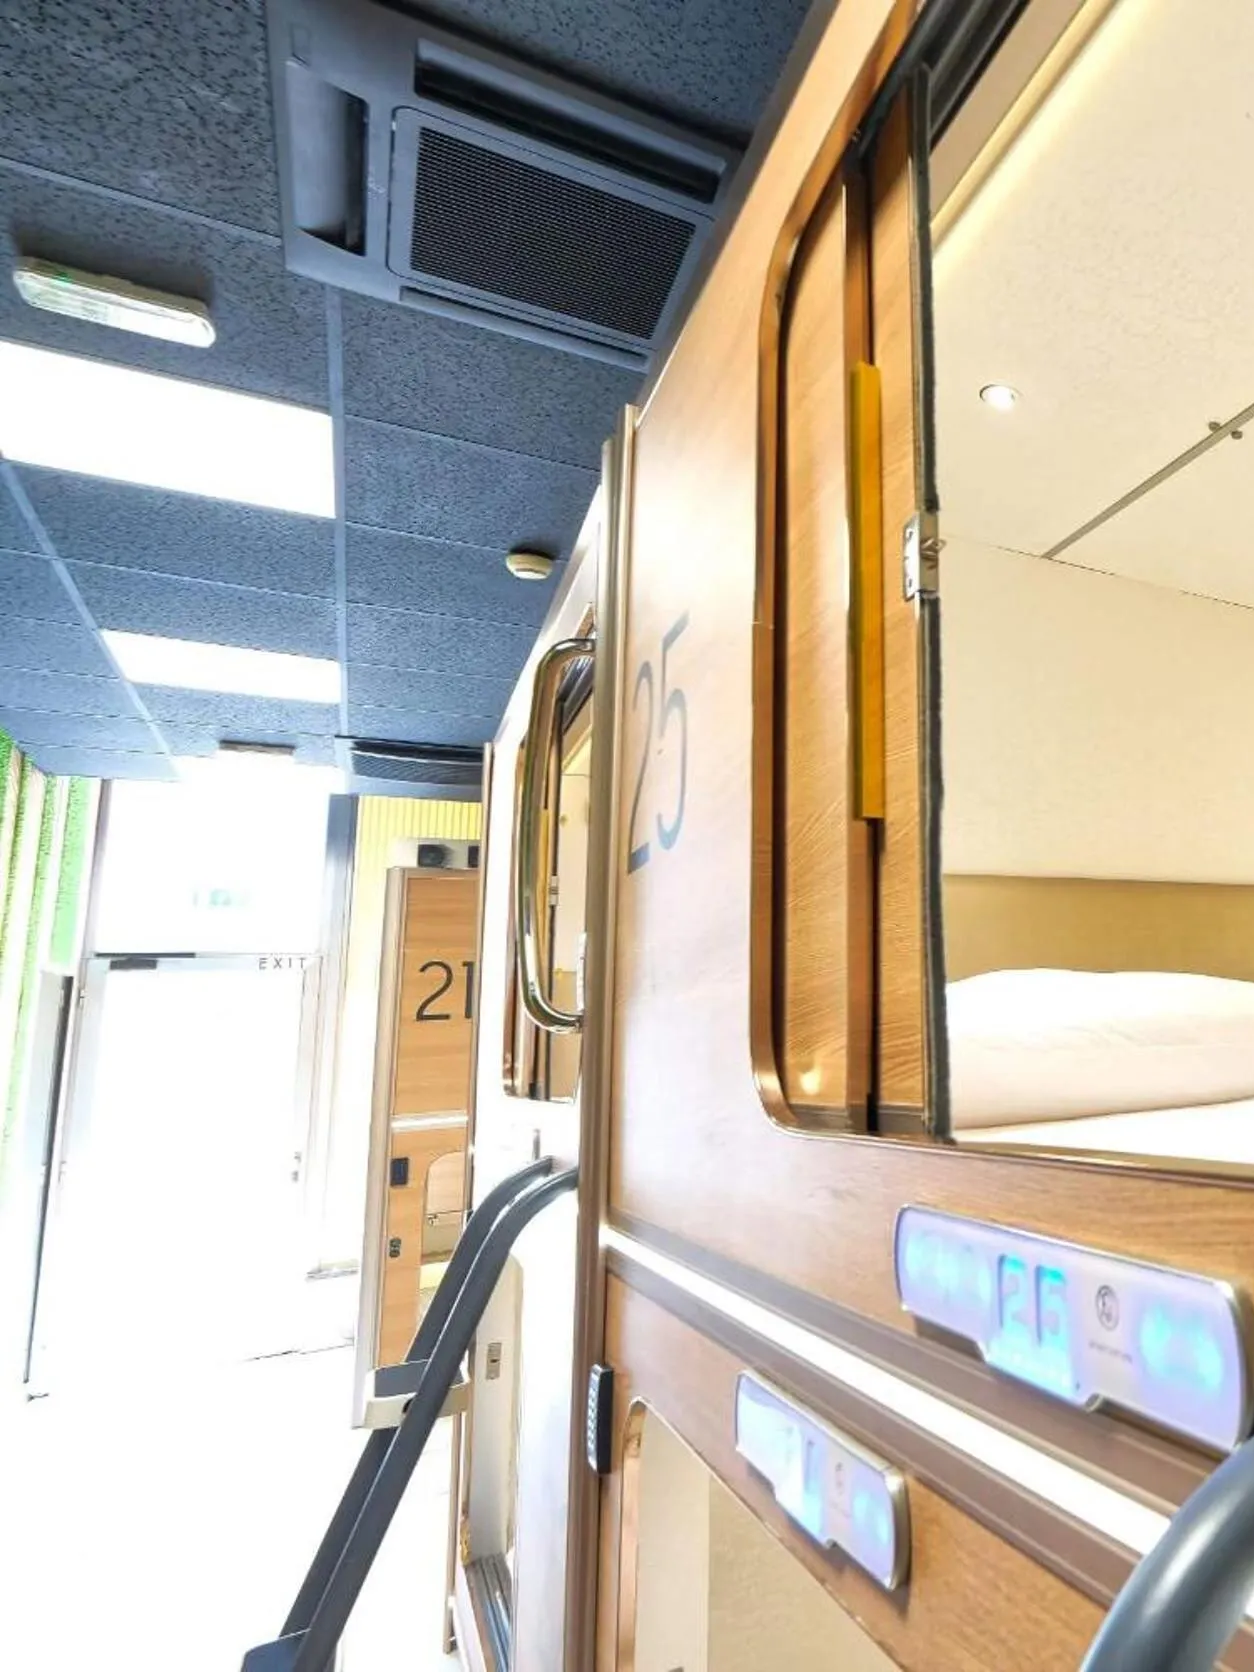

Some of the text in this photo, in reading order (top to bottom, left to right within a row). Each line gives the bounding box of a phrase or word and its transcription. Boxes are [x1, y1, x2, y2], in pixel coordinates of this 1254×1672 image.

[627, 608, 690, 874] 25
[258, 956, 308, 970] EXIT
[415, 960, 475, 1021] 21
